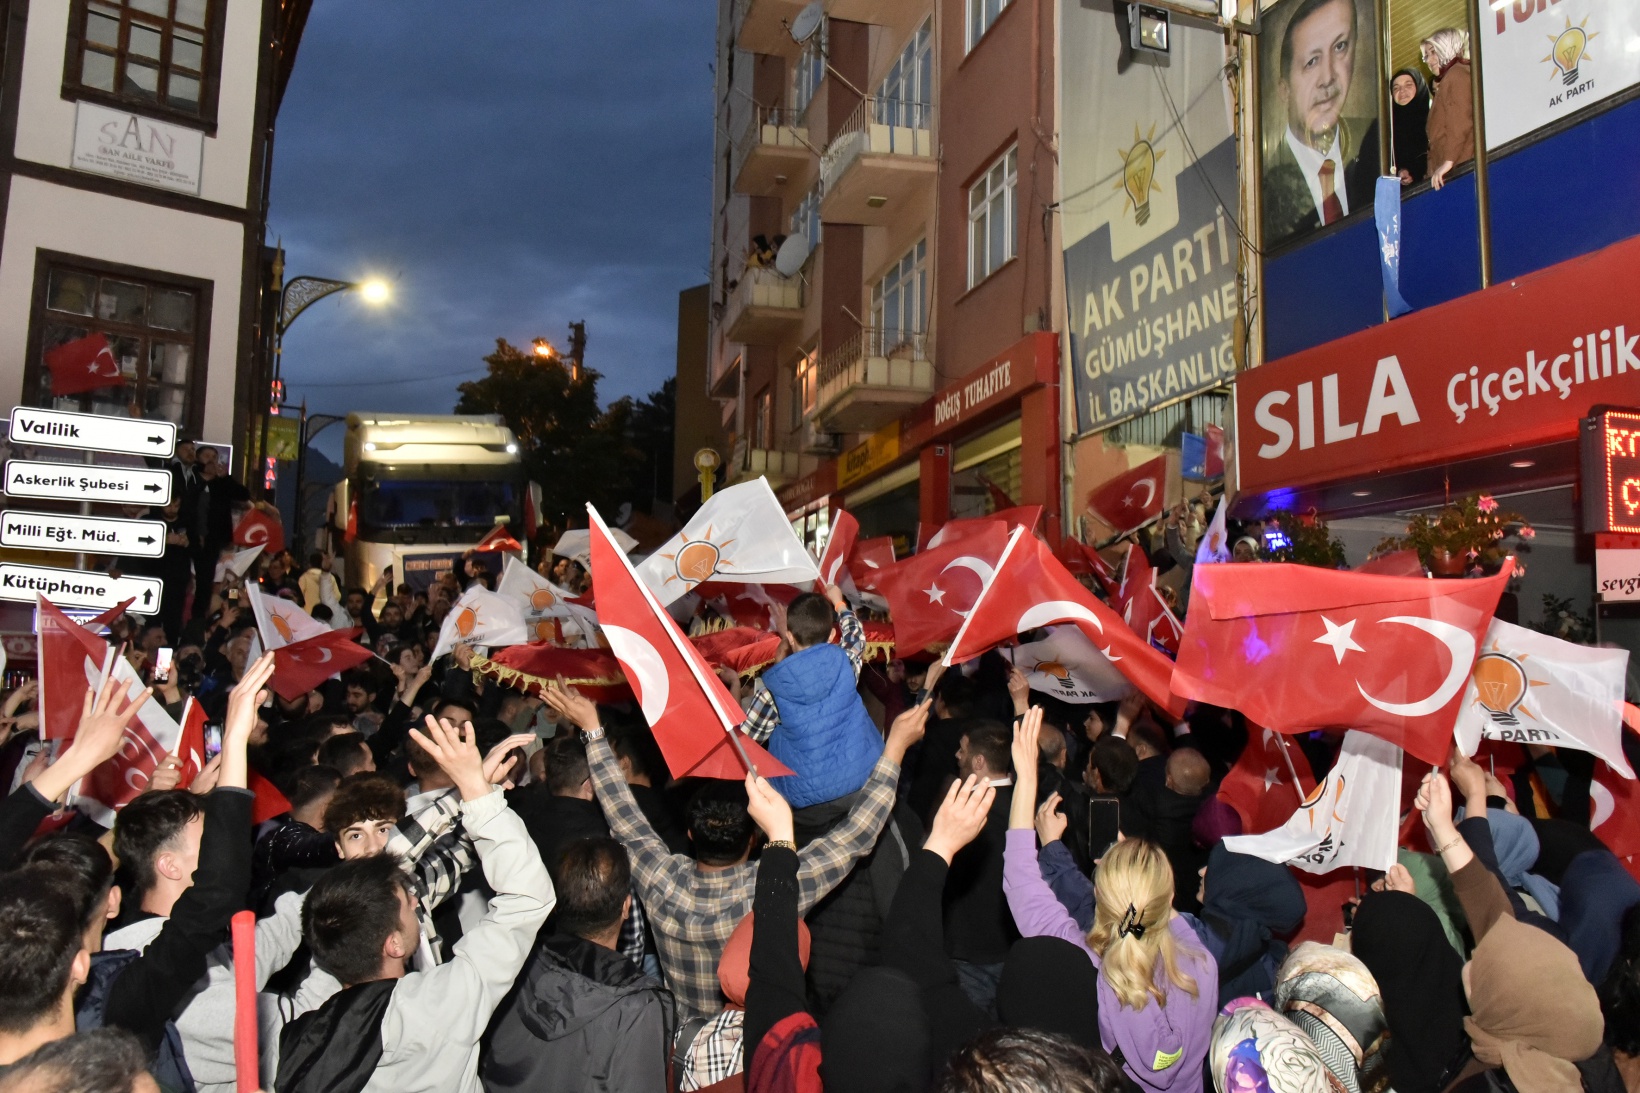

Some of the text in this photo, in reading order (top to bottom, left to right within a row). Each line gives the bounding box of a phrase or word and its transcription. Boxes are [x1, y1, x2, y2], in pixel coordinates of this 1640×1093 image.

[1549, 94, 1563, 108] AK
[98, 115, 176, 160] SAN
[102, 147, 120, 157] SAN
[1083, 205, 1229, 338] AK PARTİ
[1085, 280, 1239, 380] GÜMÜŞHANE
[934, 360, 1011, 426] DOĞUŞ TUHAFİYE
[1089, 334, 1237, 425] İL BAŞKANLIĞ
[1254, 325, 1640, 459] SILA Çiçekçilik
[20, 419, 80, 438] Valilik
[13, 473, 129, 492] Askerlik Şubesi
[7, 523, 121, 543] Milli Eğt. Müd.
[2, 573, 107, 597] Kütüphane
